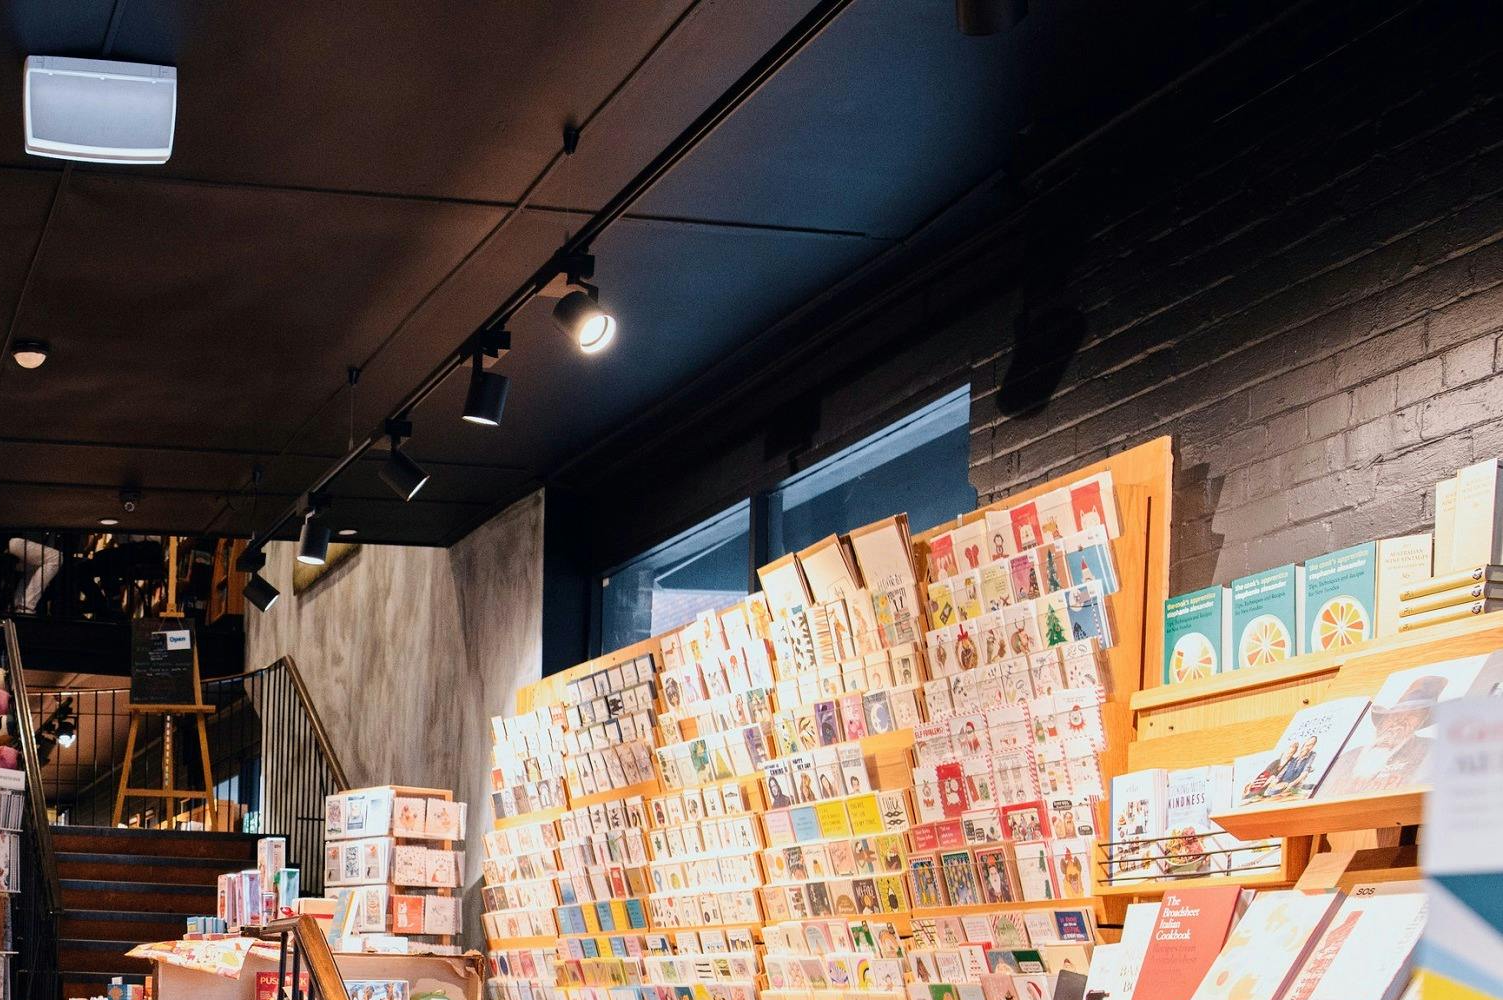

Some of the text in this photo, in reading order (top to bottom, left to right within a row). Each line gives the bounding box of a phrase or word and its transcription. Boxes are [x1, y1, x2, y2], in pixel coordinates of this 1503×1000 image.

[1389, 548, 1423, 557] AUSTRALIAN
[1168, 793, 1206, 809] KINDNESS
[1167, 896, 1181, 906] The
[1162, 907, 1200, 918] Broadsheet
[1159, 919, 1180, 929] Italian
[1156, 930, 1192, 940] Cookbook
